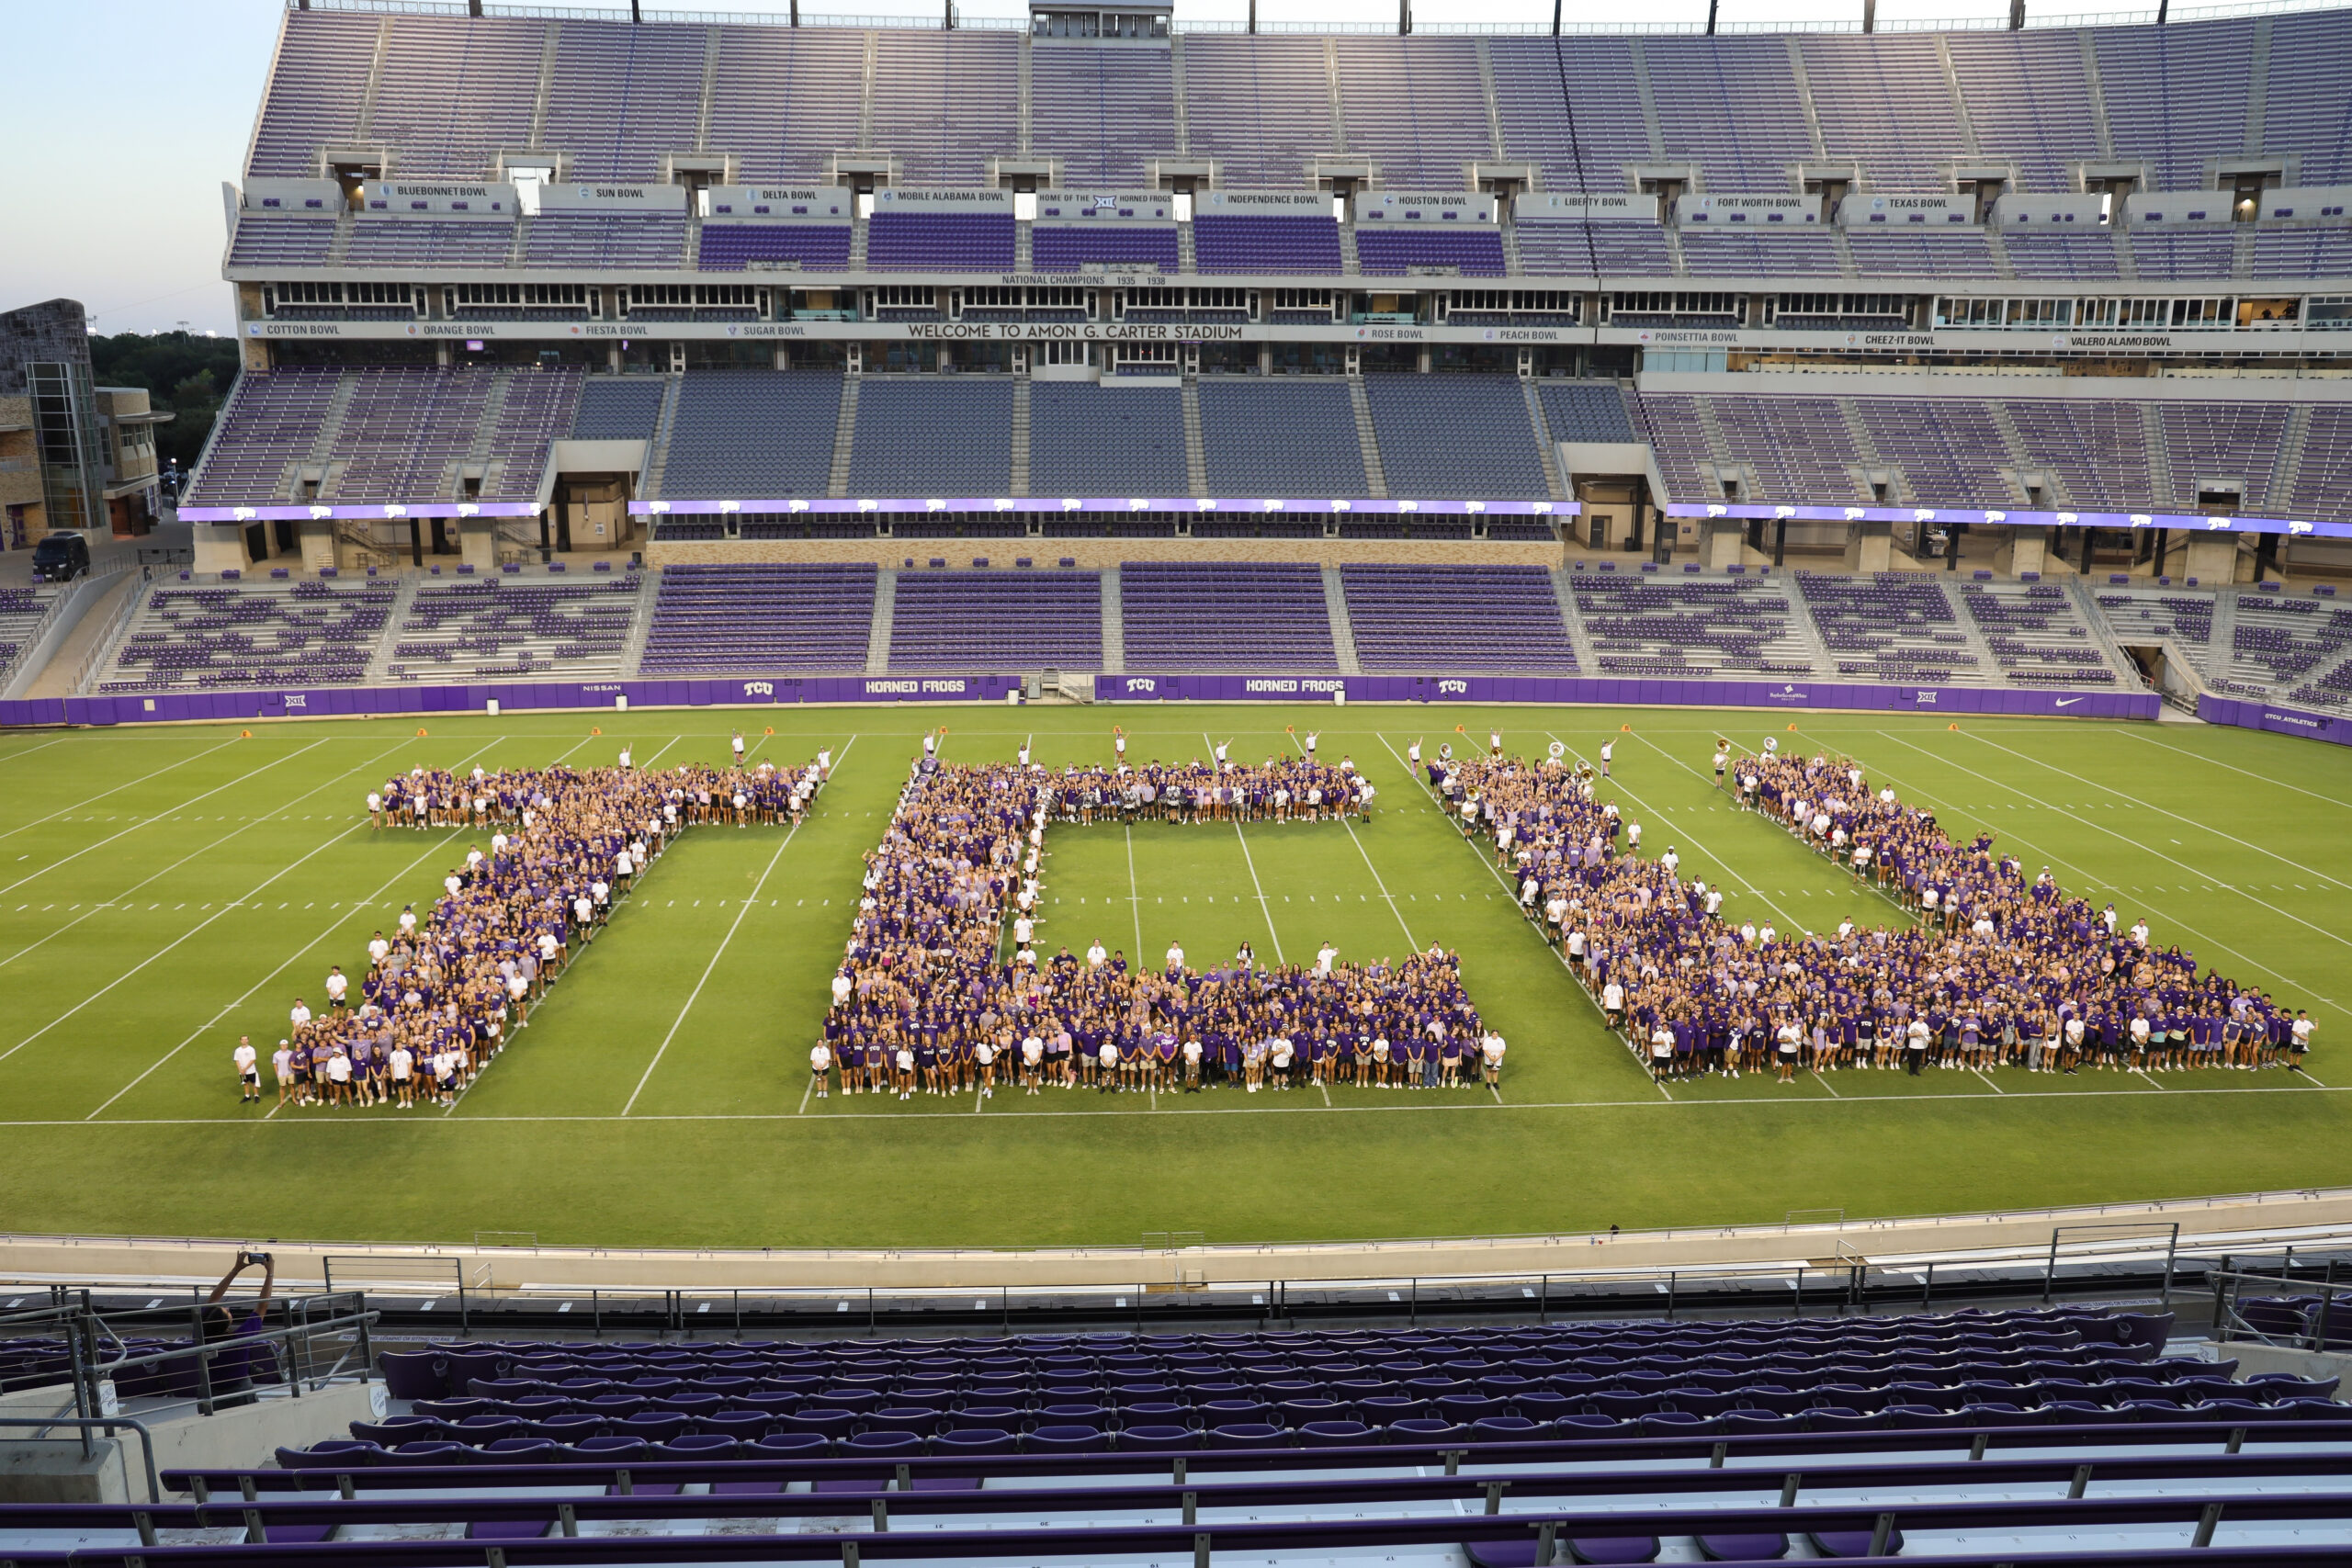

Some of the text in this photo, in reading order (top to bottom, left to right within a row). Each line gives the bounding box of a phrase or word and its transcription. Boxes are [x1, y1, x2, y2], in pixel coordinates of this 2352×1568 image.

[398, 186, 488, 197] BLUEBONNET BOWL
[596, 188, 645, 198] SUN BOWL
[763, 190, 818, 200] DELTA BOWL
[898, 192, 1005, 202] MOBILE ALABAMA BOWL
[1039, 194, 1090, 202] HOME OF THE
[1149, 195, 1172, 203] FROGS
[1227, 195, 1319, 204] INDEPENDENCE BOWL
[1398, 196, 1467, 205] HOUSTON BOWL
[1565, 197, 1628, 207] LIBERTY BOWL
[1717, 197, 1802, 208] FORT WORTH BOWL
[1889, 198, 1948, 208] TEXAS BOWL
[1002, 276, 1166, 285] NATIONAL CHAMPIONS 1935 1938
[266, 324, 340, 334] COTTON BOWL
[424, 325, 495, 334] ORANGE BOWL
[586, 325, 648, 335] FIESTA BOWL
[743, 325, 806, 335] SUGAR BOWL
[908, 324, 1241, 339] WELCOME TO AMON G. CARTER STADIUM
[1372, 330, 1424, 339] ROSE BOWL
[1499, 331, 1558, 340] PEACH BOWL
[1655, 332, 1738, 342] POINSETTIA BOWL
[1865, 335, 1935, 345] CHEEZ-IT BOWL
[2071, 337, 2172, 346] VALERO ALAMO BOWL
[744, 682, 774, 696] TCU
[865, 680, 965, 694] HORNED FROGS
[1126, 679, 1156, 693] TCU
[1246, 680, 1344, 692] HORNED FROGS
[1439, 680, 1467, 694] TCU
[2264, 713, 2318, 728] @TCU_ATHLETICS
